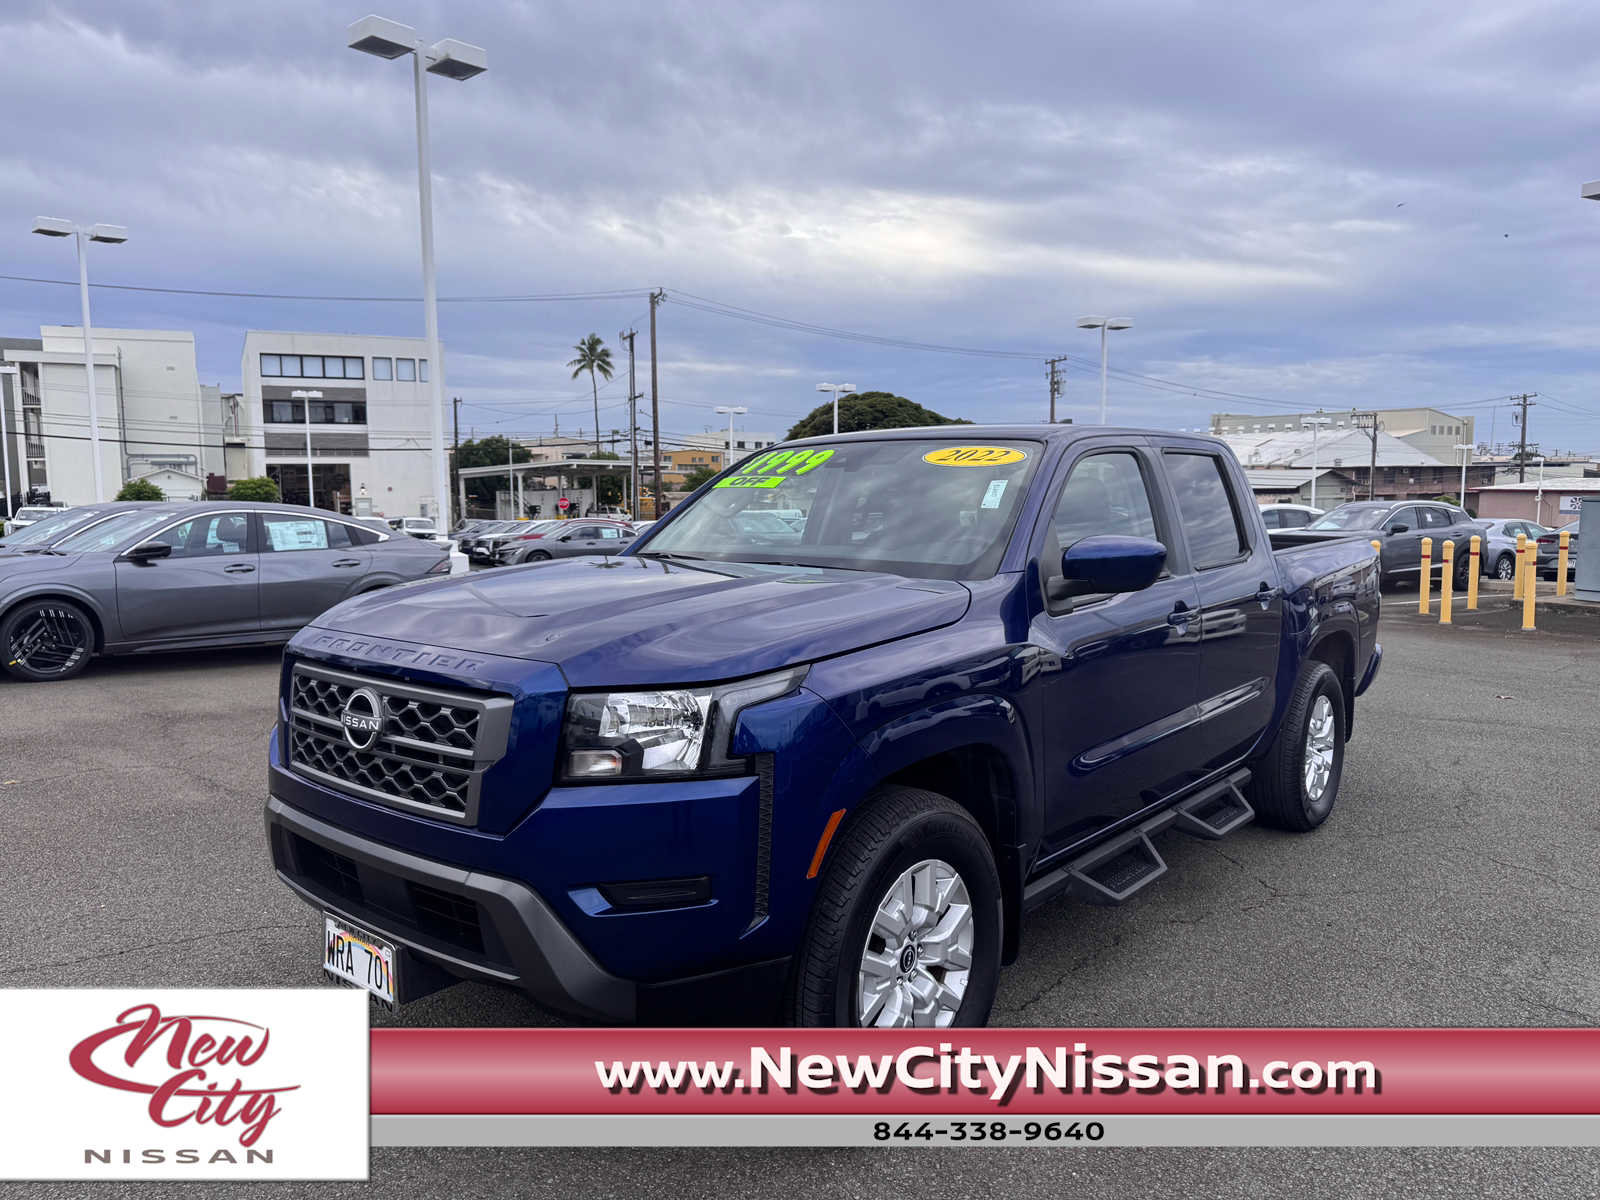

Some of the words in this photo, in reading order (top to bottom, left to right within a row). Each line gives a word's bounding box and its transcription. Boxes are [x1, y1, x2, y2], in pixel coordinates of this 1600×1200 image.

[933, 449, 1011, 462] 2022
[729, 476, 770, 486] OFF
[313, 634, 486, 672] FRONTIER
[327, 930, 354, 976] WRA
[364, 949, 390, 994] 701
[323, 968, 393, 1013] NISAN
